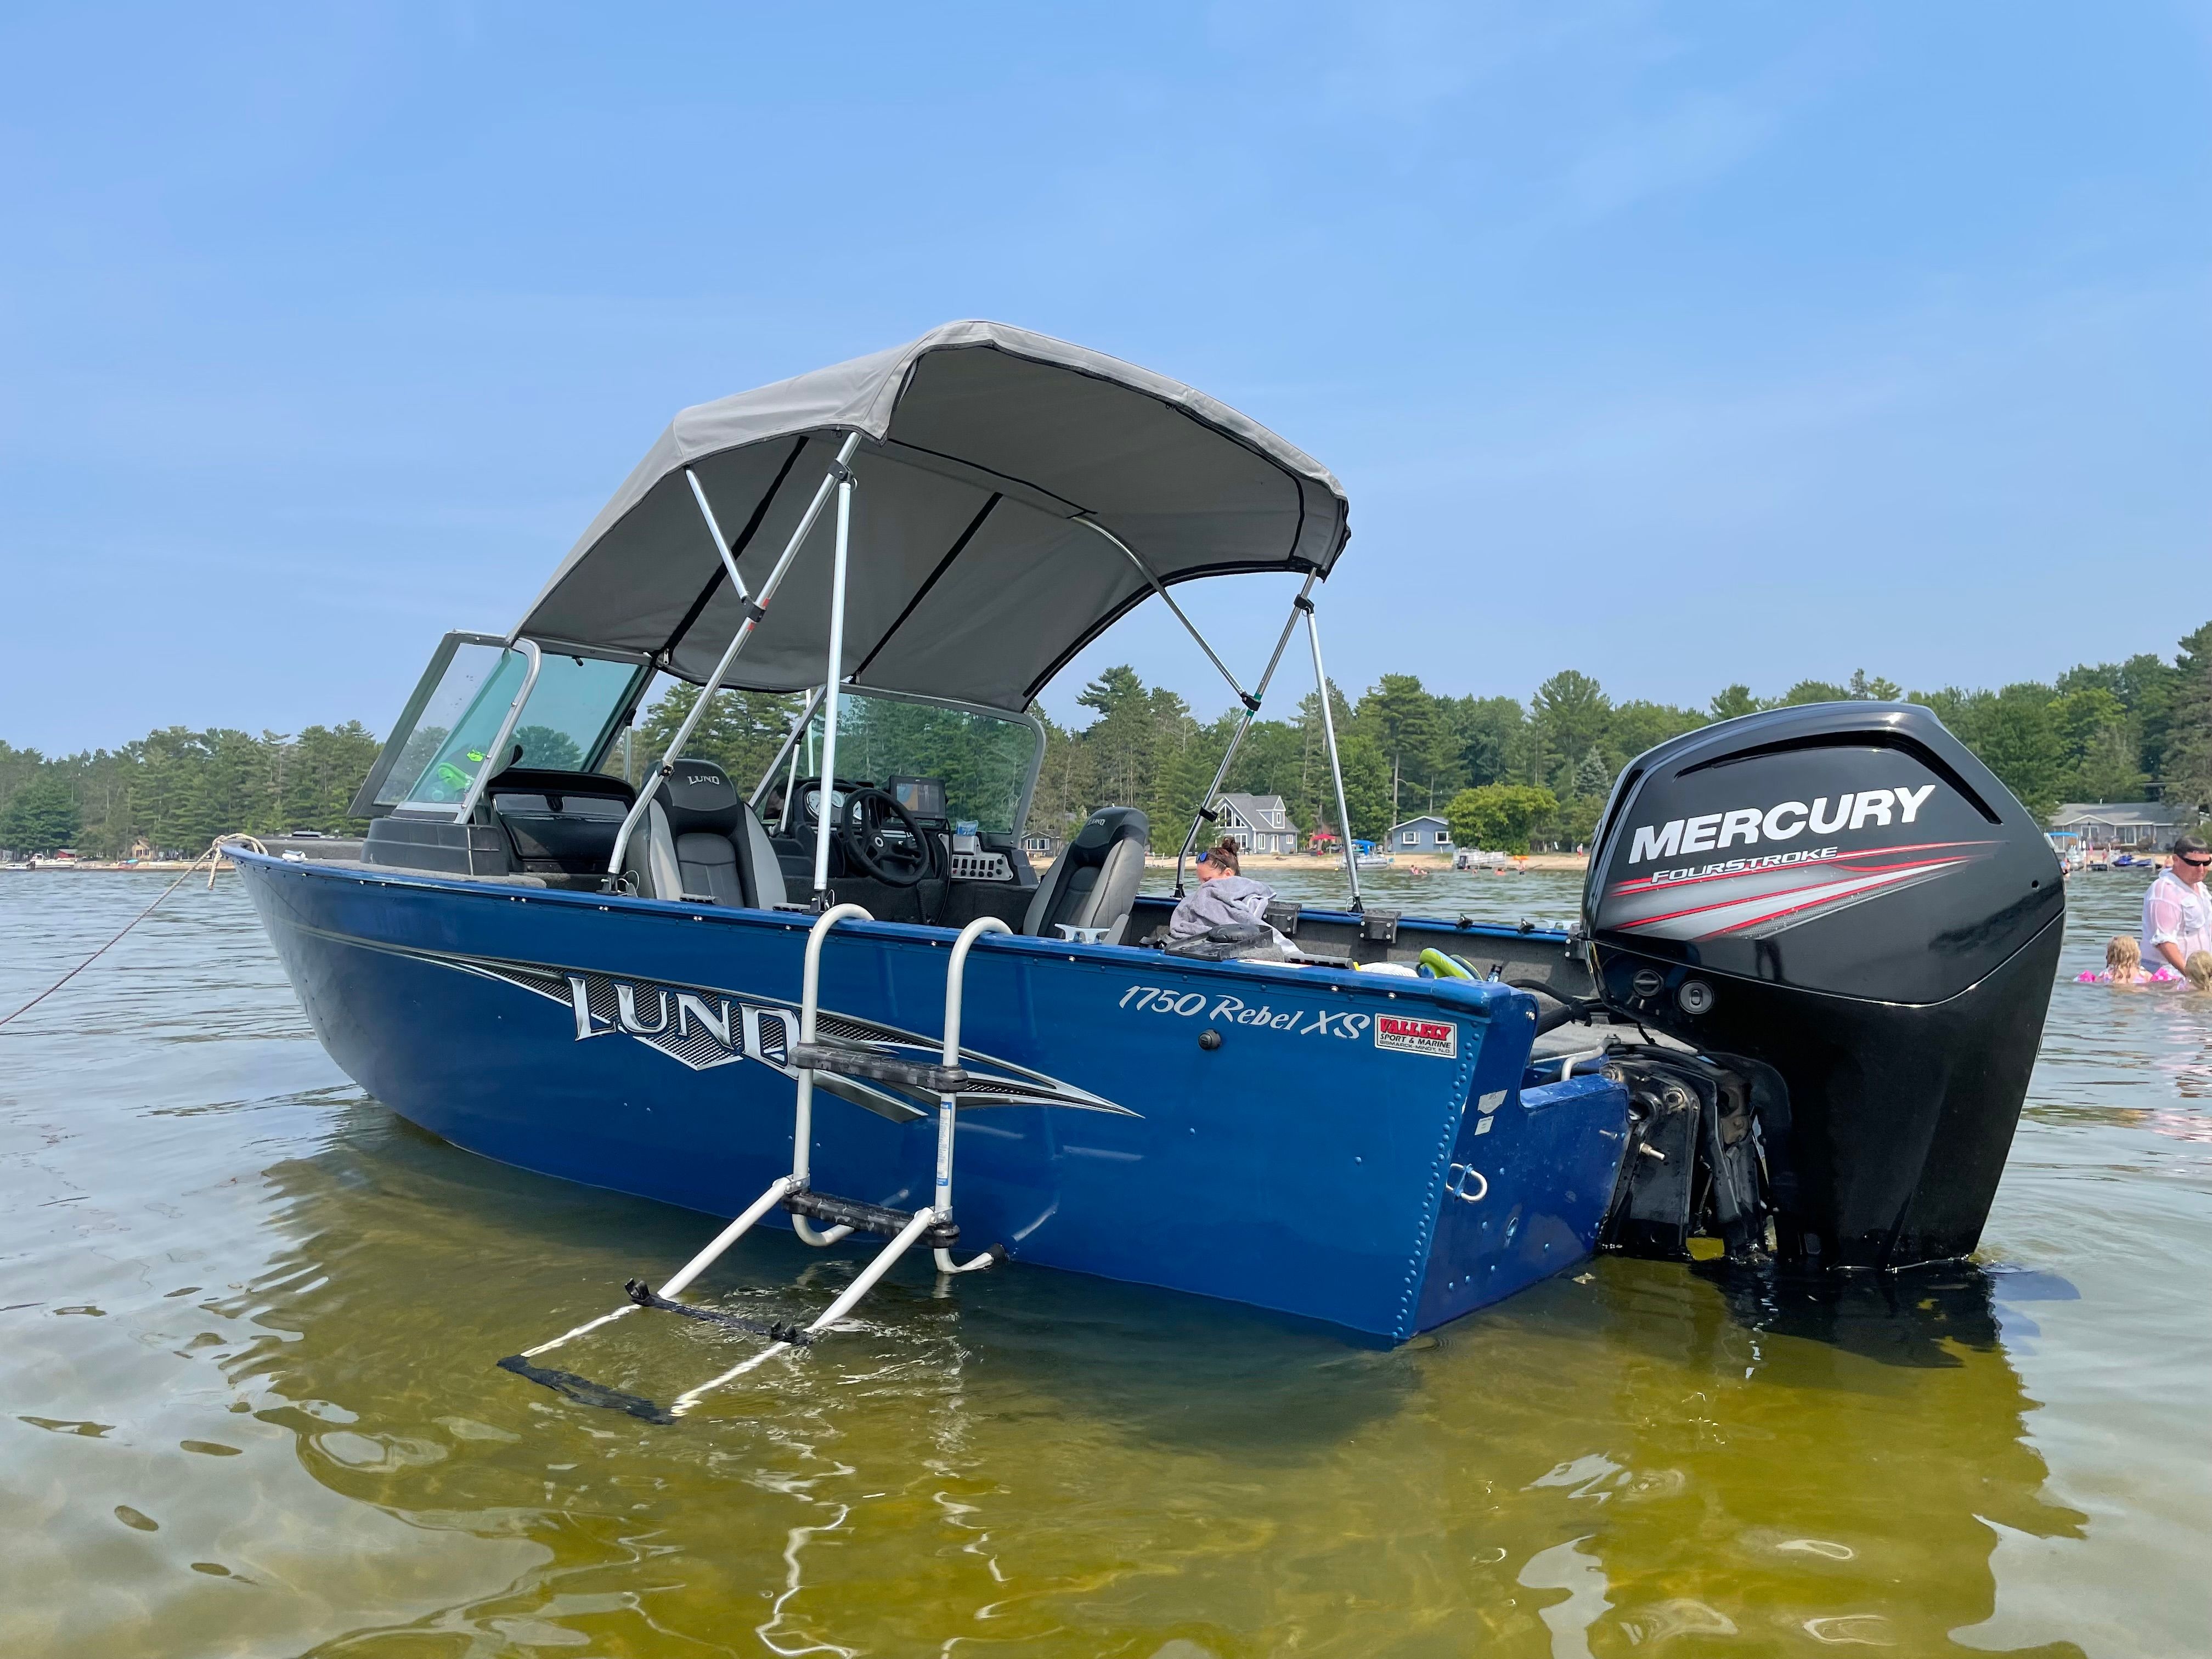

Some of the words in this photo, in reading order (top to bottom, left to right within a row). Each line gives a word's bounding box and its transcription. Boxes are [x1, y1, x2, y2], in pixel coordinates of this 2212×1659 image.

[687, 775, 720, 786] LUND
[1628, 784, 1936, 864] MERCURY
[1651, 846, 1838, 883] FOURSTROKE
[567, 976, 802, 1080] LUND
[1119, 985, 1206, 1017] 1750
[1209, 994, 1304, 1031] Rebel
[1301, 1010, 1370, 1039] XS
[1380, 1034, 1407, 1043] SPORT
[1418, 1038, 1452, 1049] MARINE
